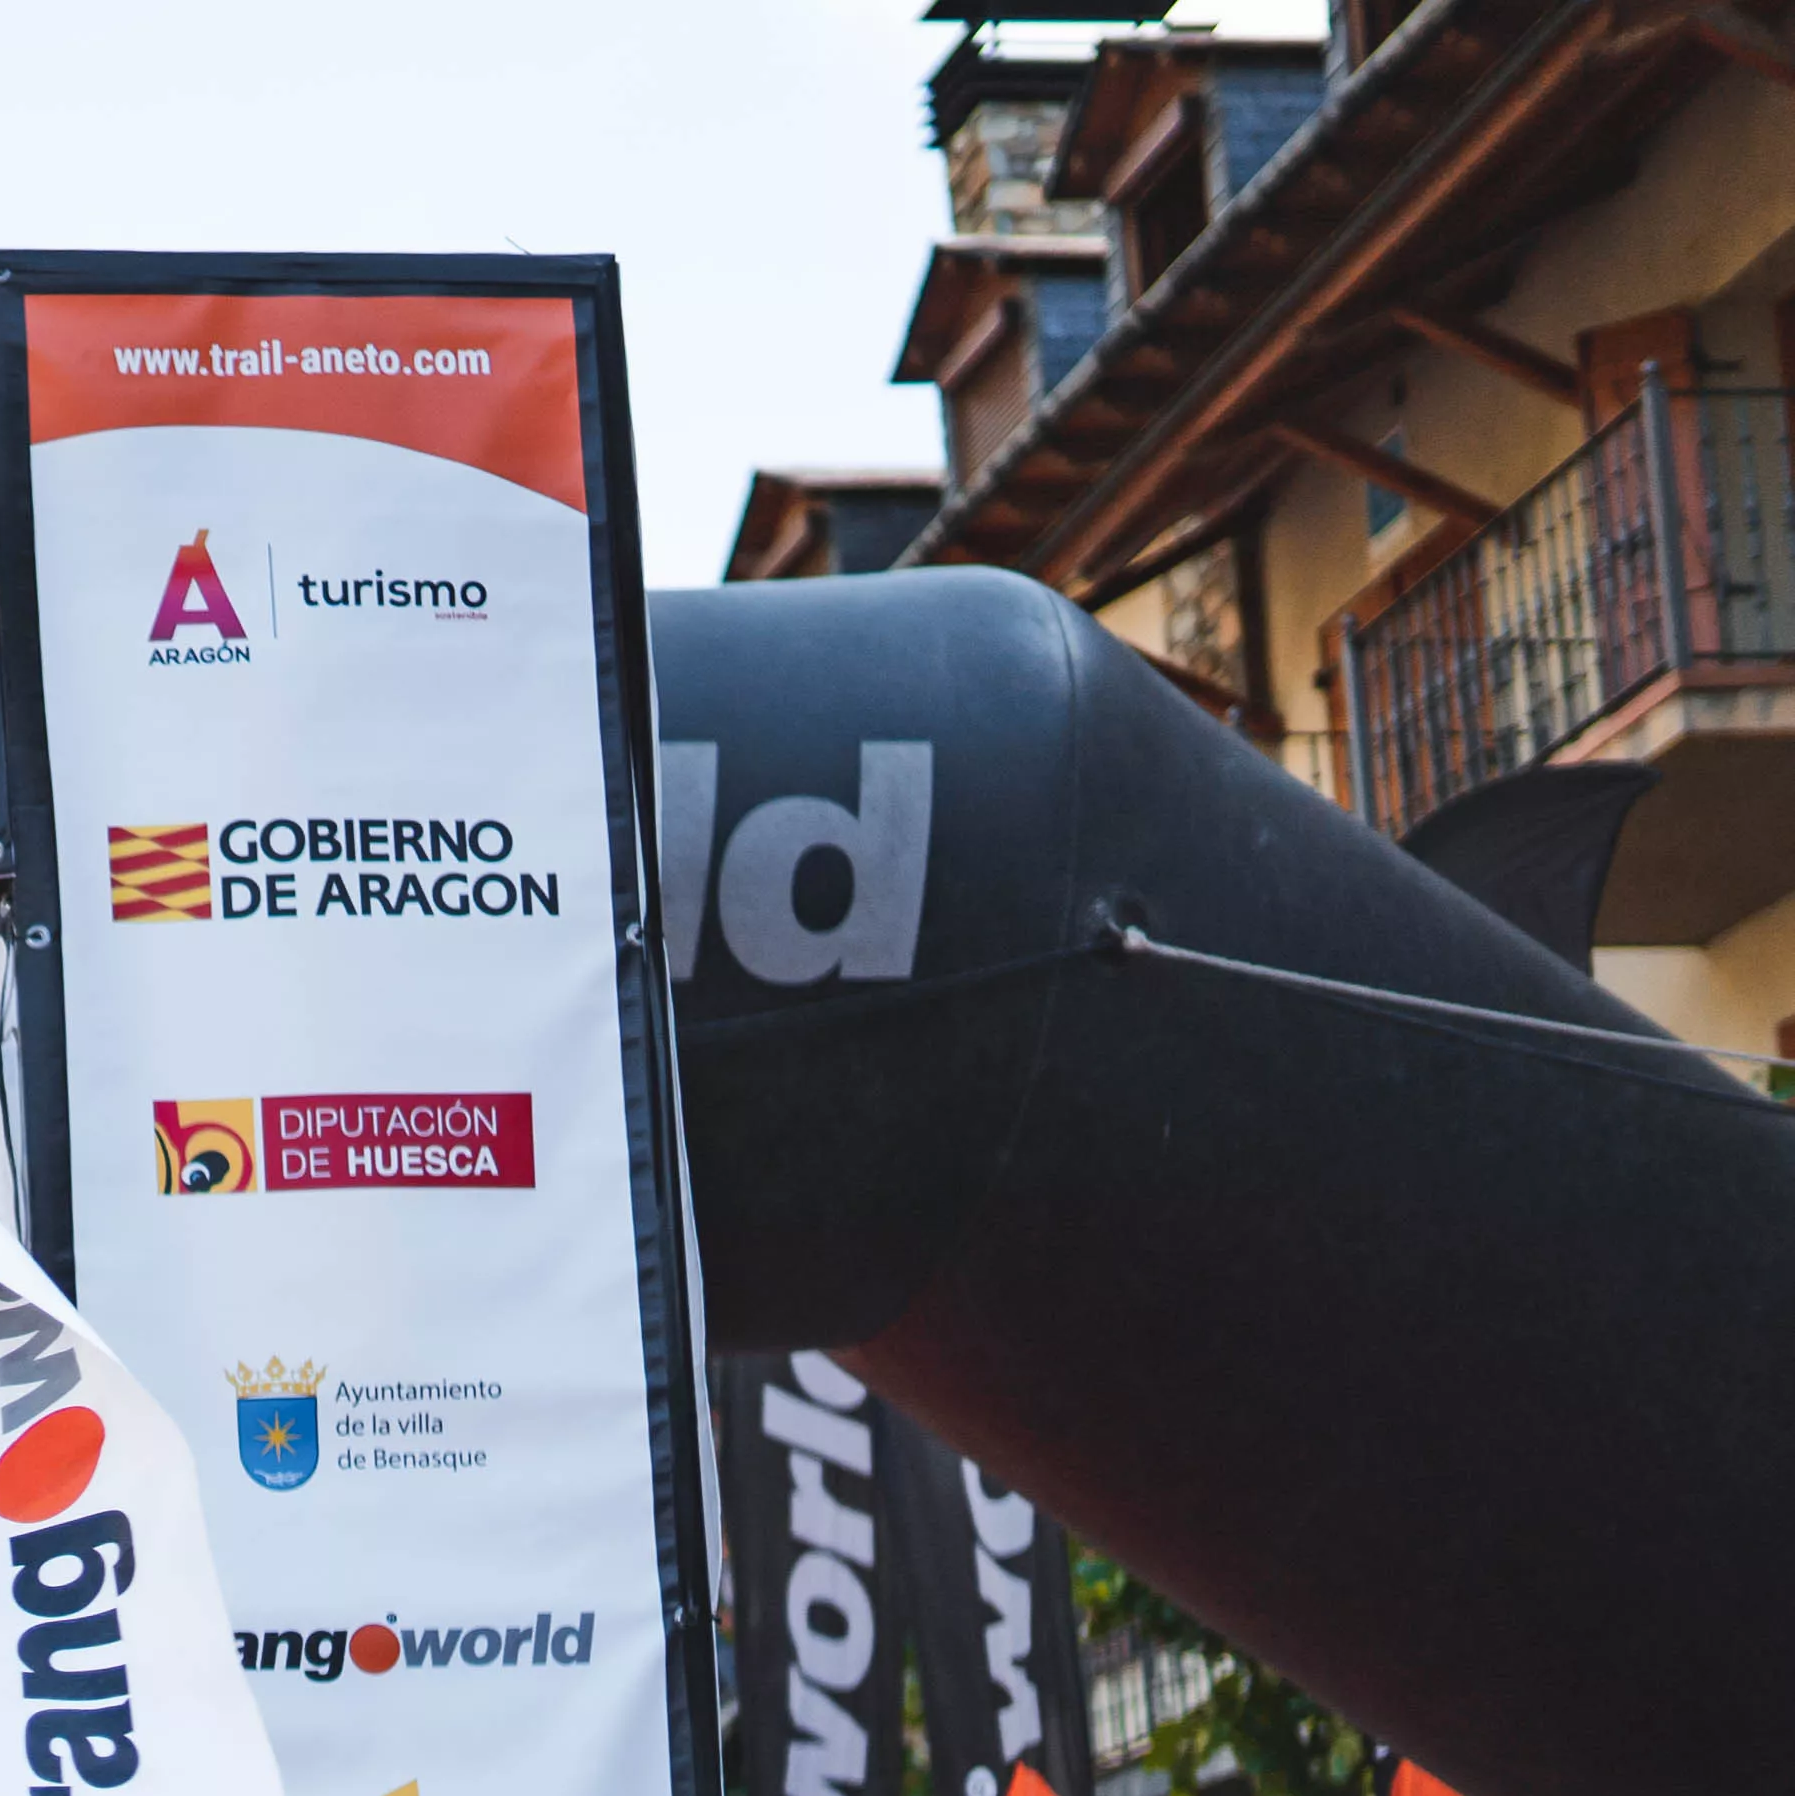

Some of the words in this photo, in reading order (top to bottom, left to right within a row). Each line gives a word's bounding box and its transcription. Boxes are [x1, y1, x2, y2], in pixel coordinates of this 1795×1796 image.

[114, 340, 490, 377] www.trail-aneto.com
[298, 570, 487, 610] turismo
[148, 641, 250, 666] ARAGÓN
[219, 818, 513, 864] GOBIERNO
[222, 875, 296, 918] DE
[317, 873, 559, 917] ARAGON
[281, 1100, 497, 1140] DIPUTACIÓN
[282, 1147, 330, 1180] DE
[347, 1145, 499, 1179] HUESCA
[335, 1378, 502, 1404] Ayuntamiento
[336, 1415, 365, 1435] de
[374, 1415, 391, 1435] la
[398, 1414, 443, 1435] villa
[337, 1449, 366, 1470] de
[374, 1448, 487, 1472] Benasque
[234, 1612, 595, 1683] angoworld
